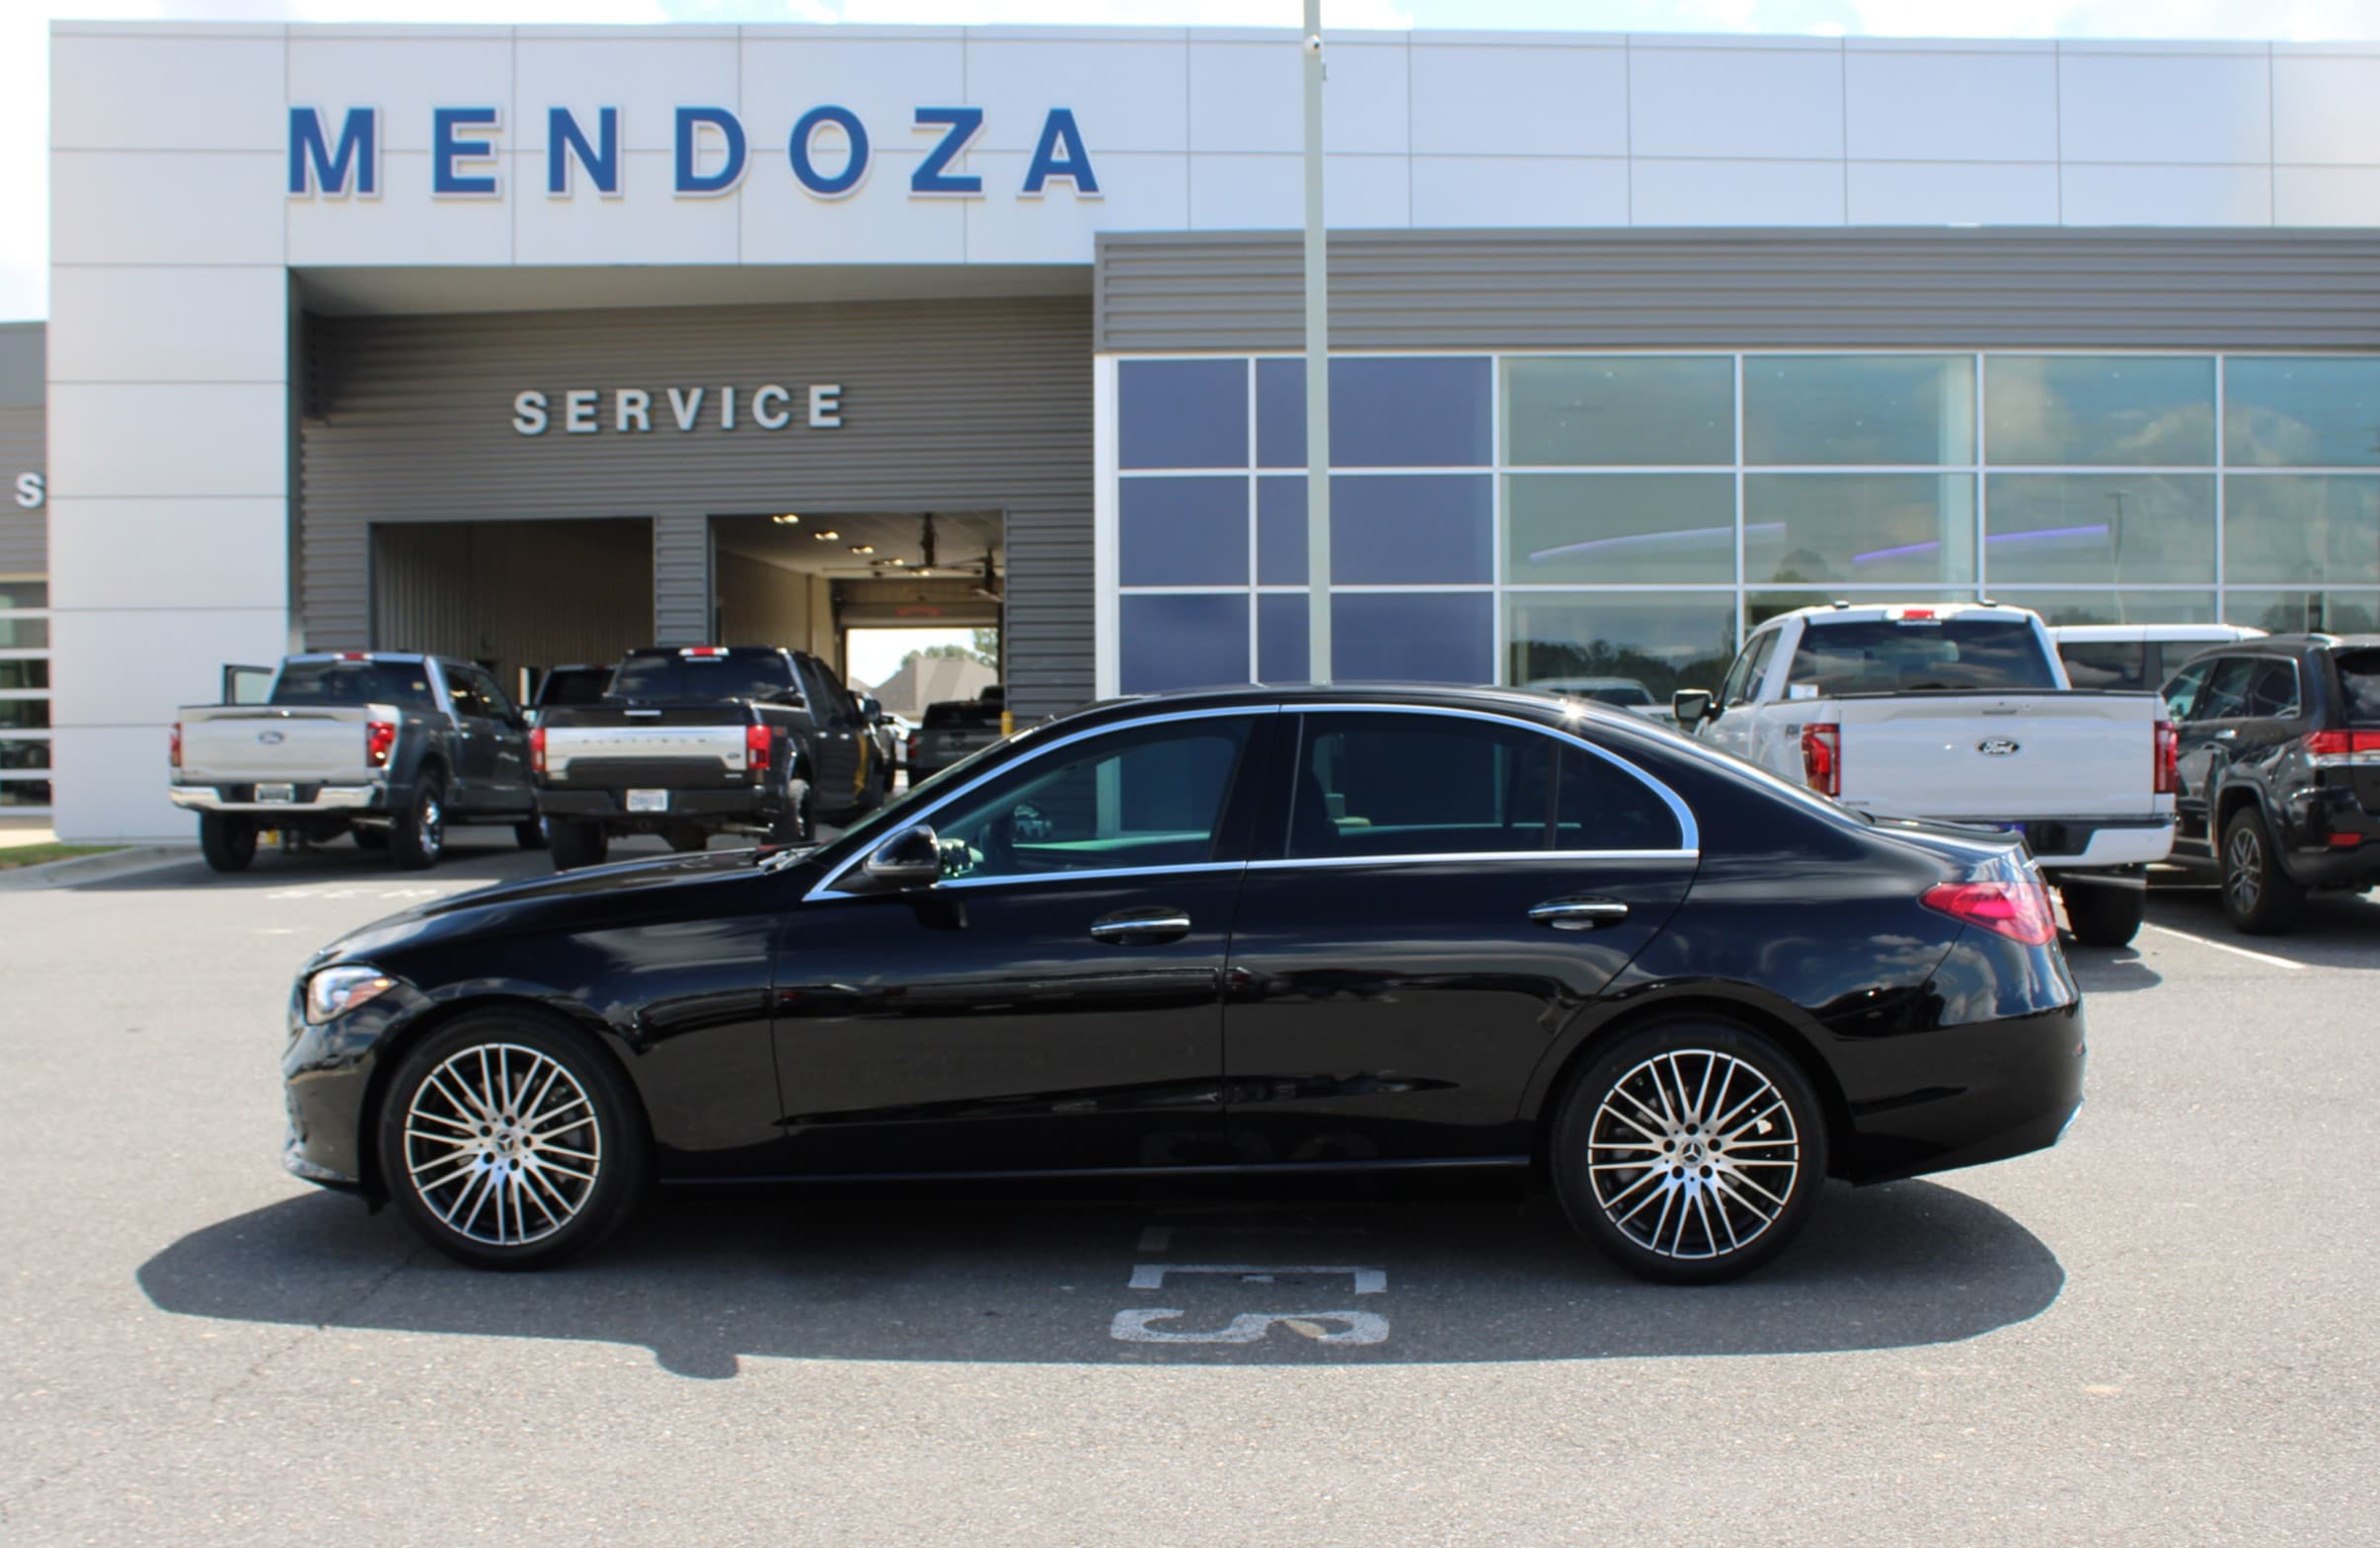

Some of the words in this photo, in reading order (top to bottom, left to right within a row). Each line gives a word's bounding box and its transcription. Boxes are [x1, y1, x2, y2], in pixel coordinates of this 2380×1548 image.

[287, 106, 1102, 199] MENDOZA
[511, 382, 844, 436] SERVICE
[15, 471, 45, 508] S
